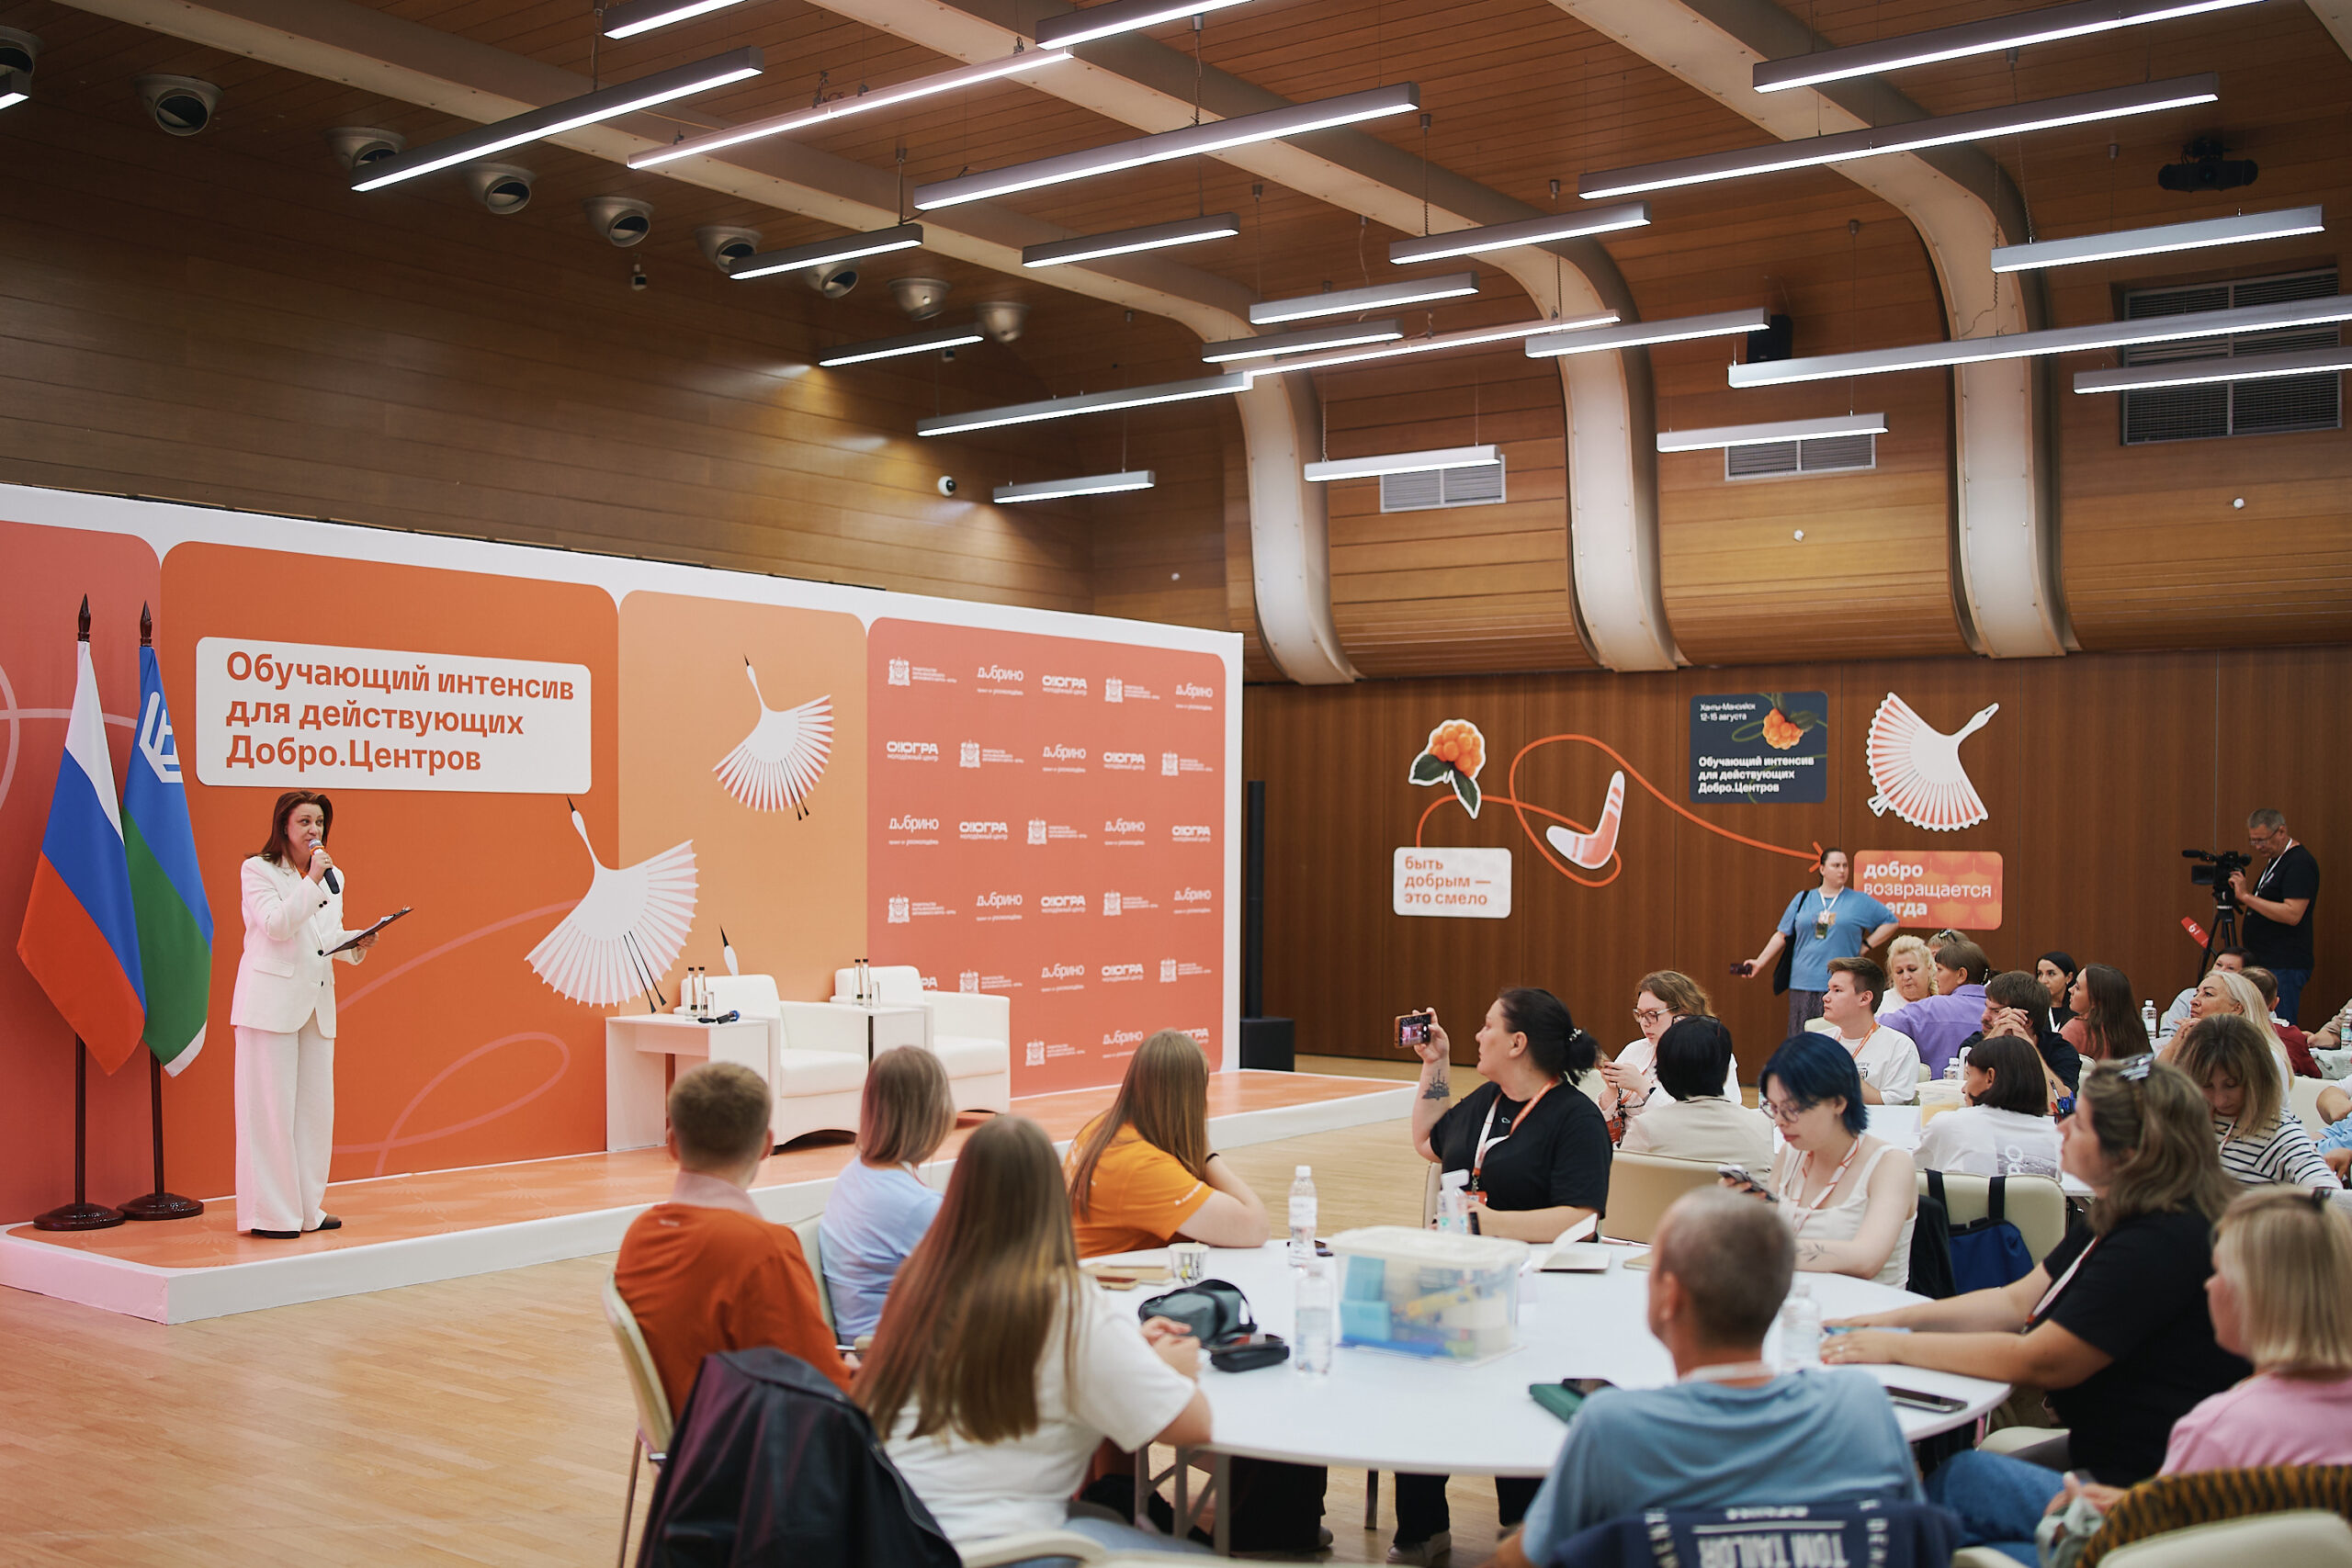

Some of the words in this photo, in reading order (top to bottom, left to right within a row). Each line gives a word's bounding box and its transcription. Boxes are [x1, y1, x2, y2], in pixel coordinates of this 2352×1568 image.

[227, 651, 430, 694] Обучающий
[438, 673, 574, 700] интенсив
[226, 701, 290, 728] для
[300, 700, 524, 738] действующих
[226, 734, 482, 775] Добро.Центров
[1699, 756, 1762, 769] Обучающий
[1764, 757, 1815, 766] интенсив
[1698, 771, 1718, 782] для
[1719, 769, 1795, 782] действующих
[1698, 782, 1780, 795] Добро.Центров
[1405, 856, 1443, 870] быть
[1863, 861, 1923, 881] добро
[1405, 873, 1470, 890] добрым
[1863, 883, 1992, 899] возвращается
[1405, 893, 1430, 904] это
[1435, 894, 1487, 905] смело
[1886, 902, 1928, 917] егда
